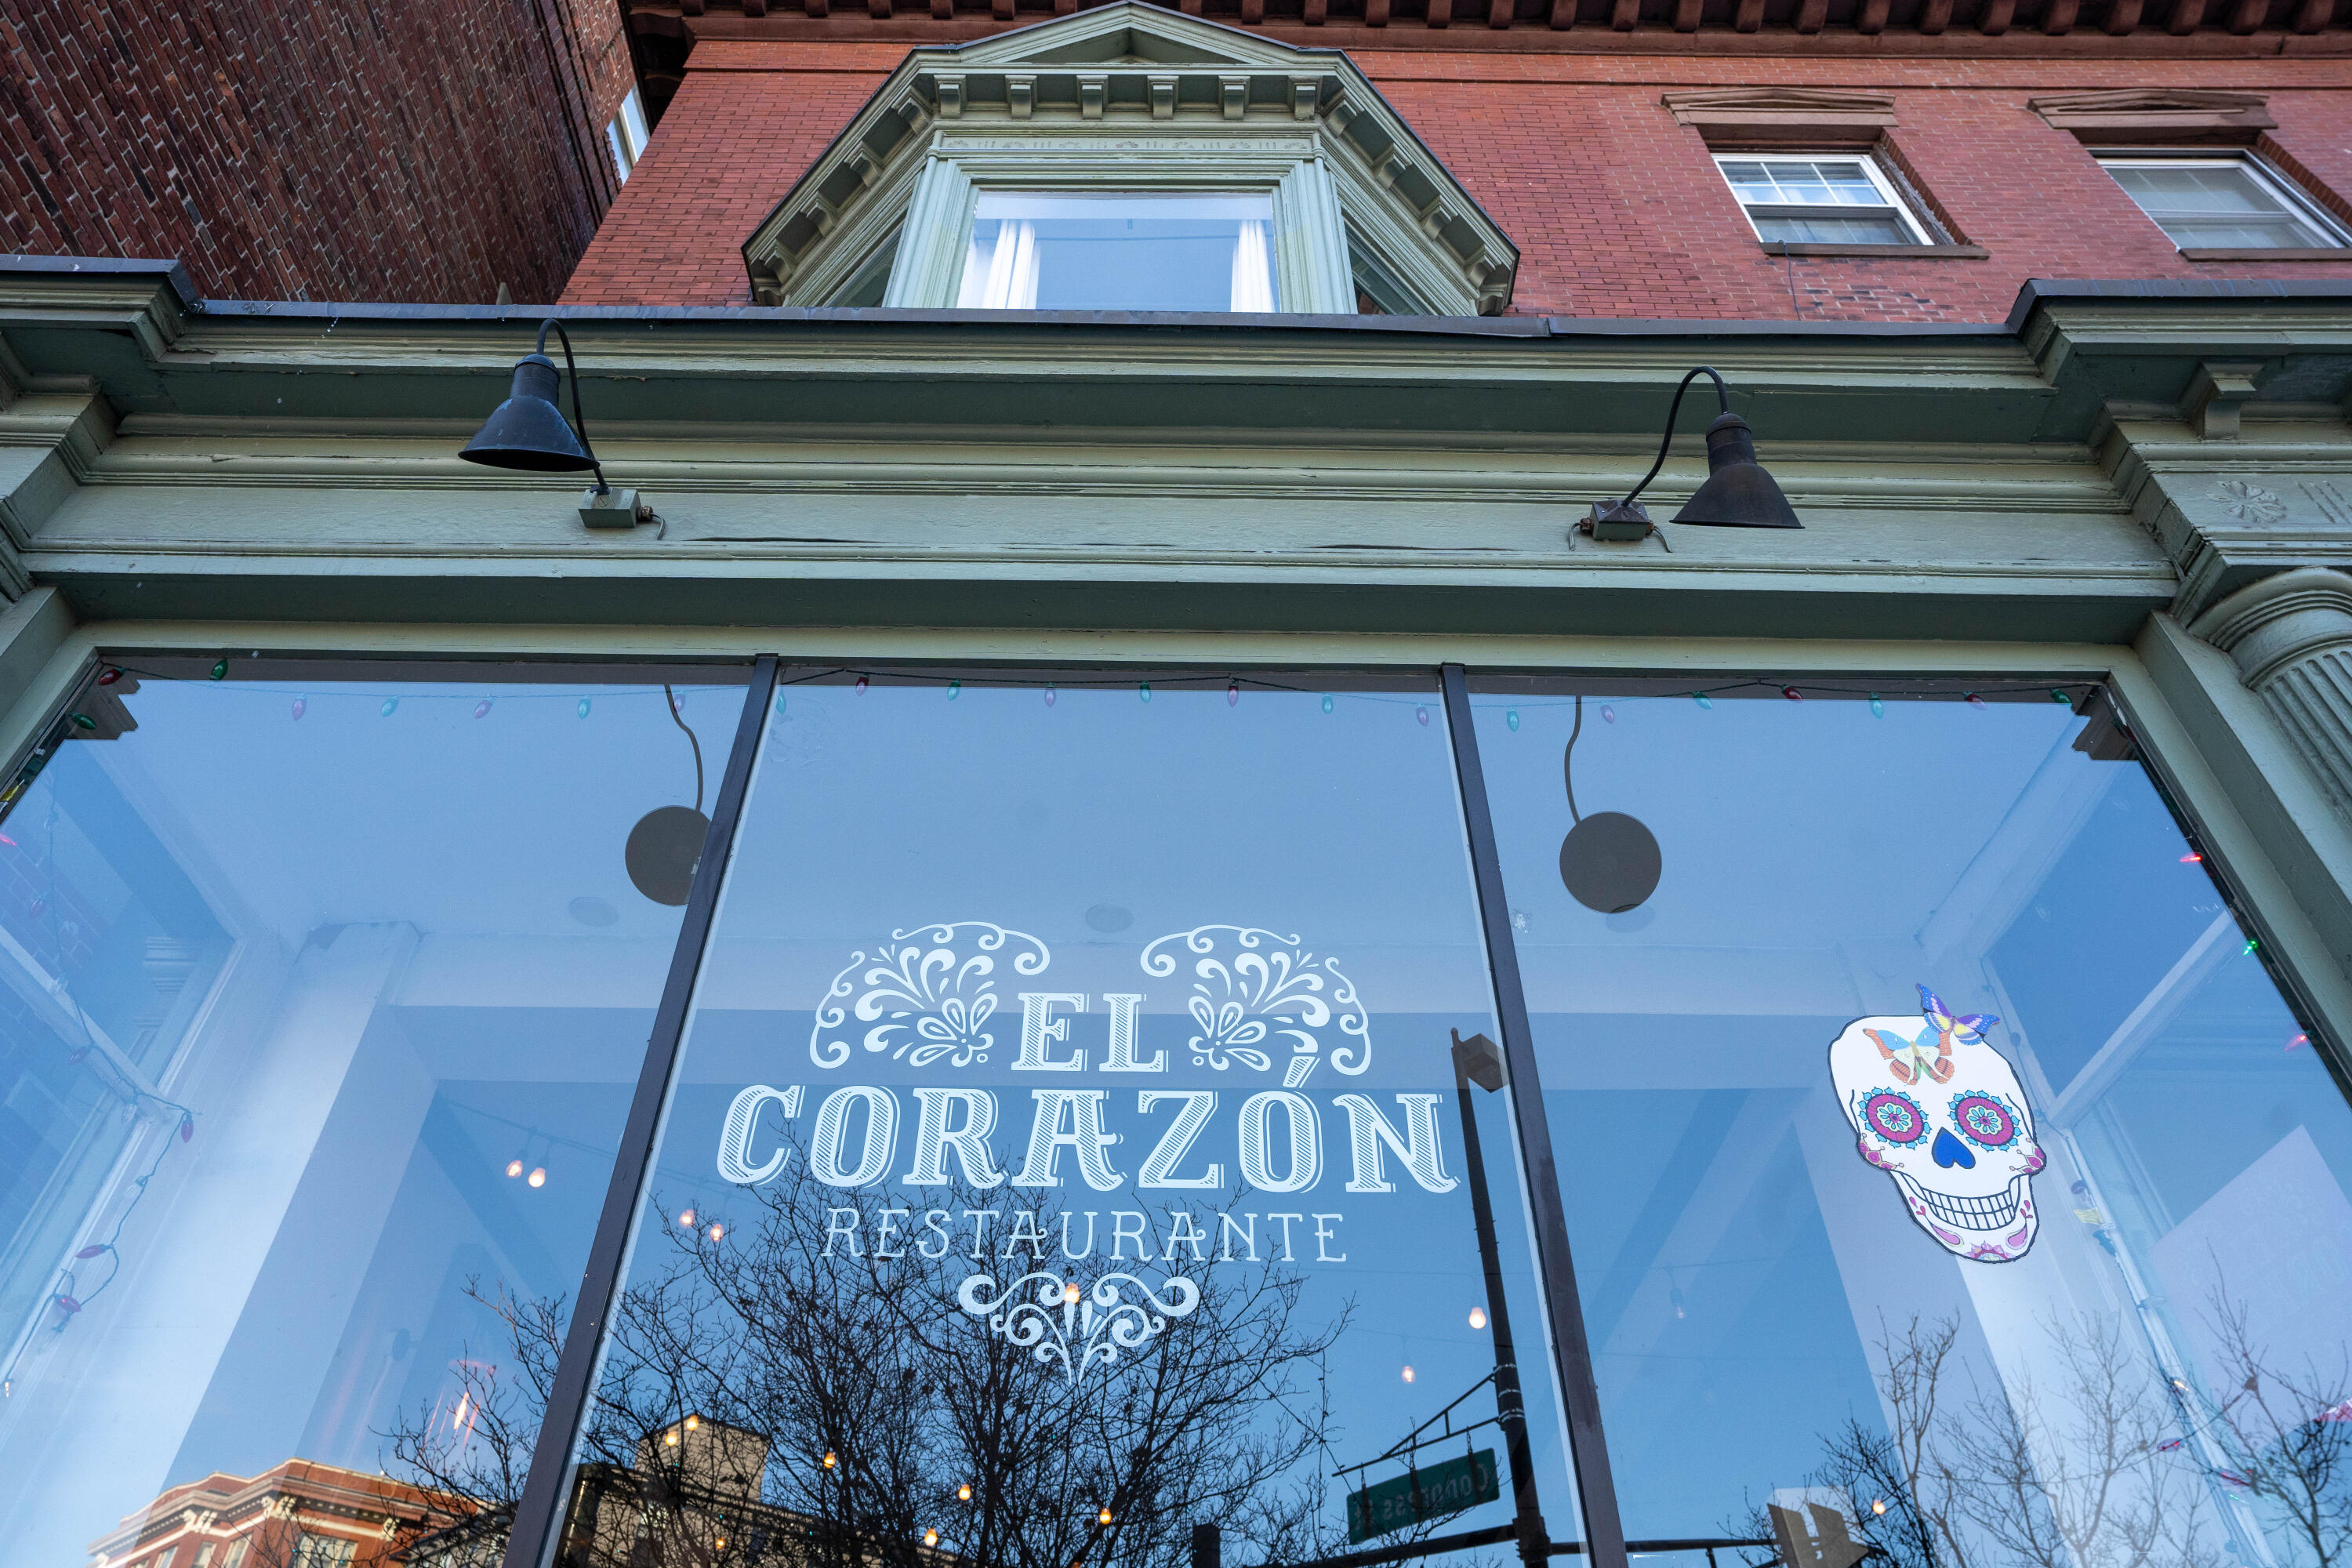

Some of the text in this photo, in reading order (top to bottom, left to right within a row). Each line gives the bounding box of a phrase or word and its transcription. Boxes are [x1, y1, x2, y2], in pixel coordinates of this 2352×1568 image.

[1011, 992, 1168, 1073] EL
[717, 1055, 1461, 1194] CORAZÓN
[821, 1207, 1347, 1263] RESTAURANTE
